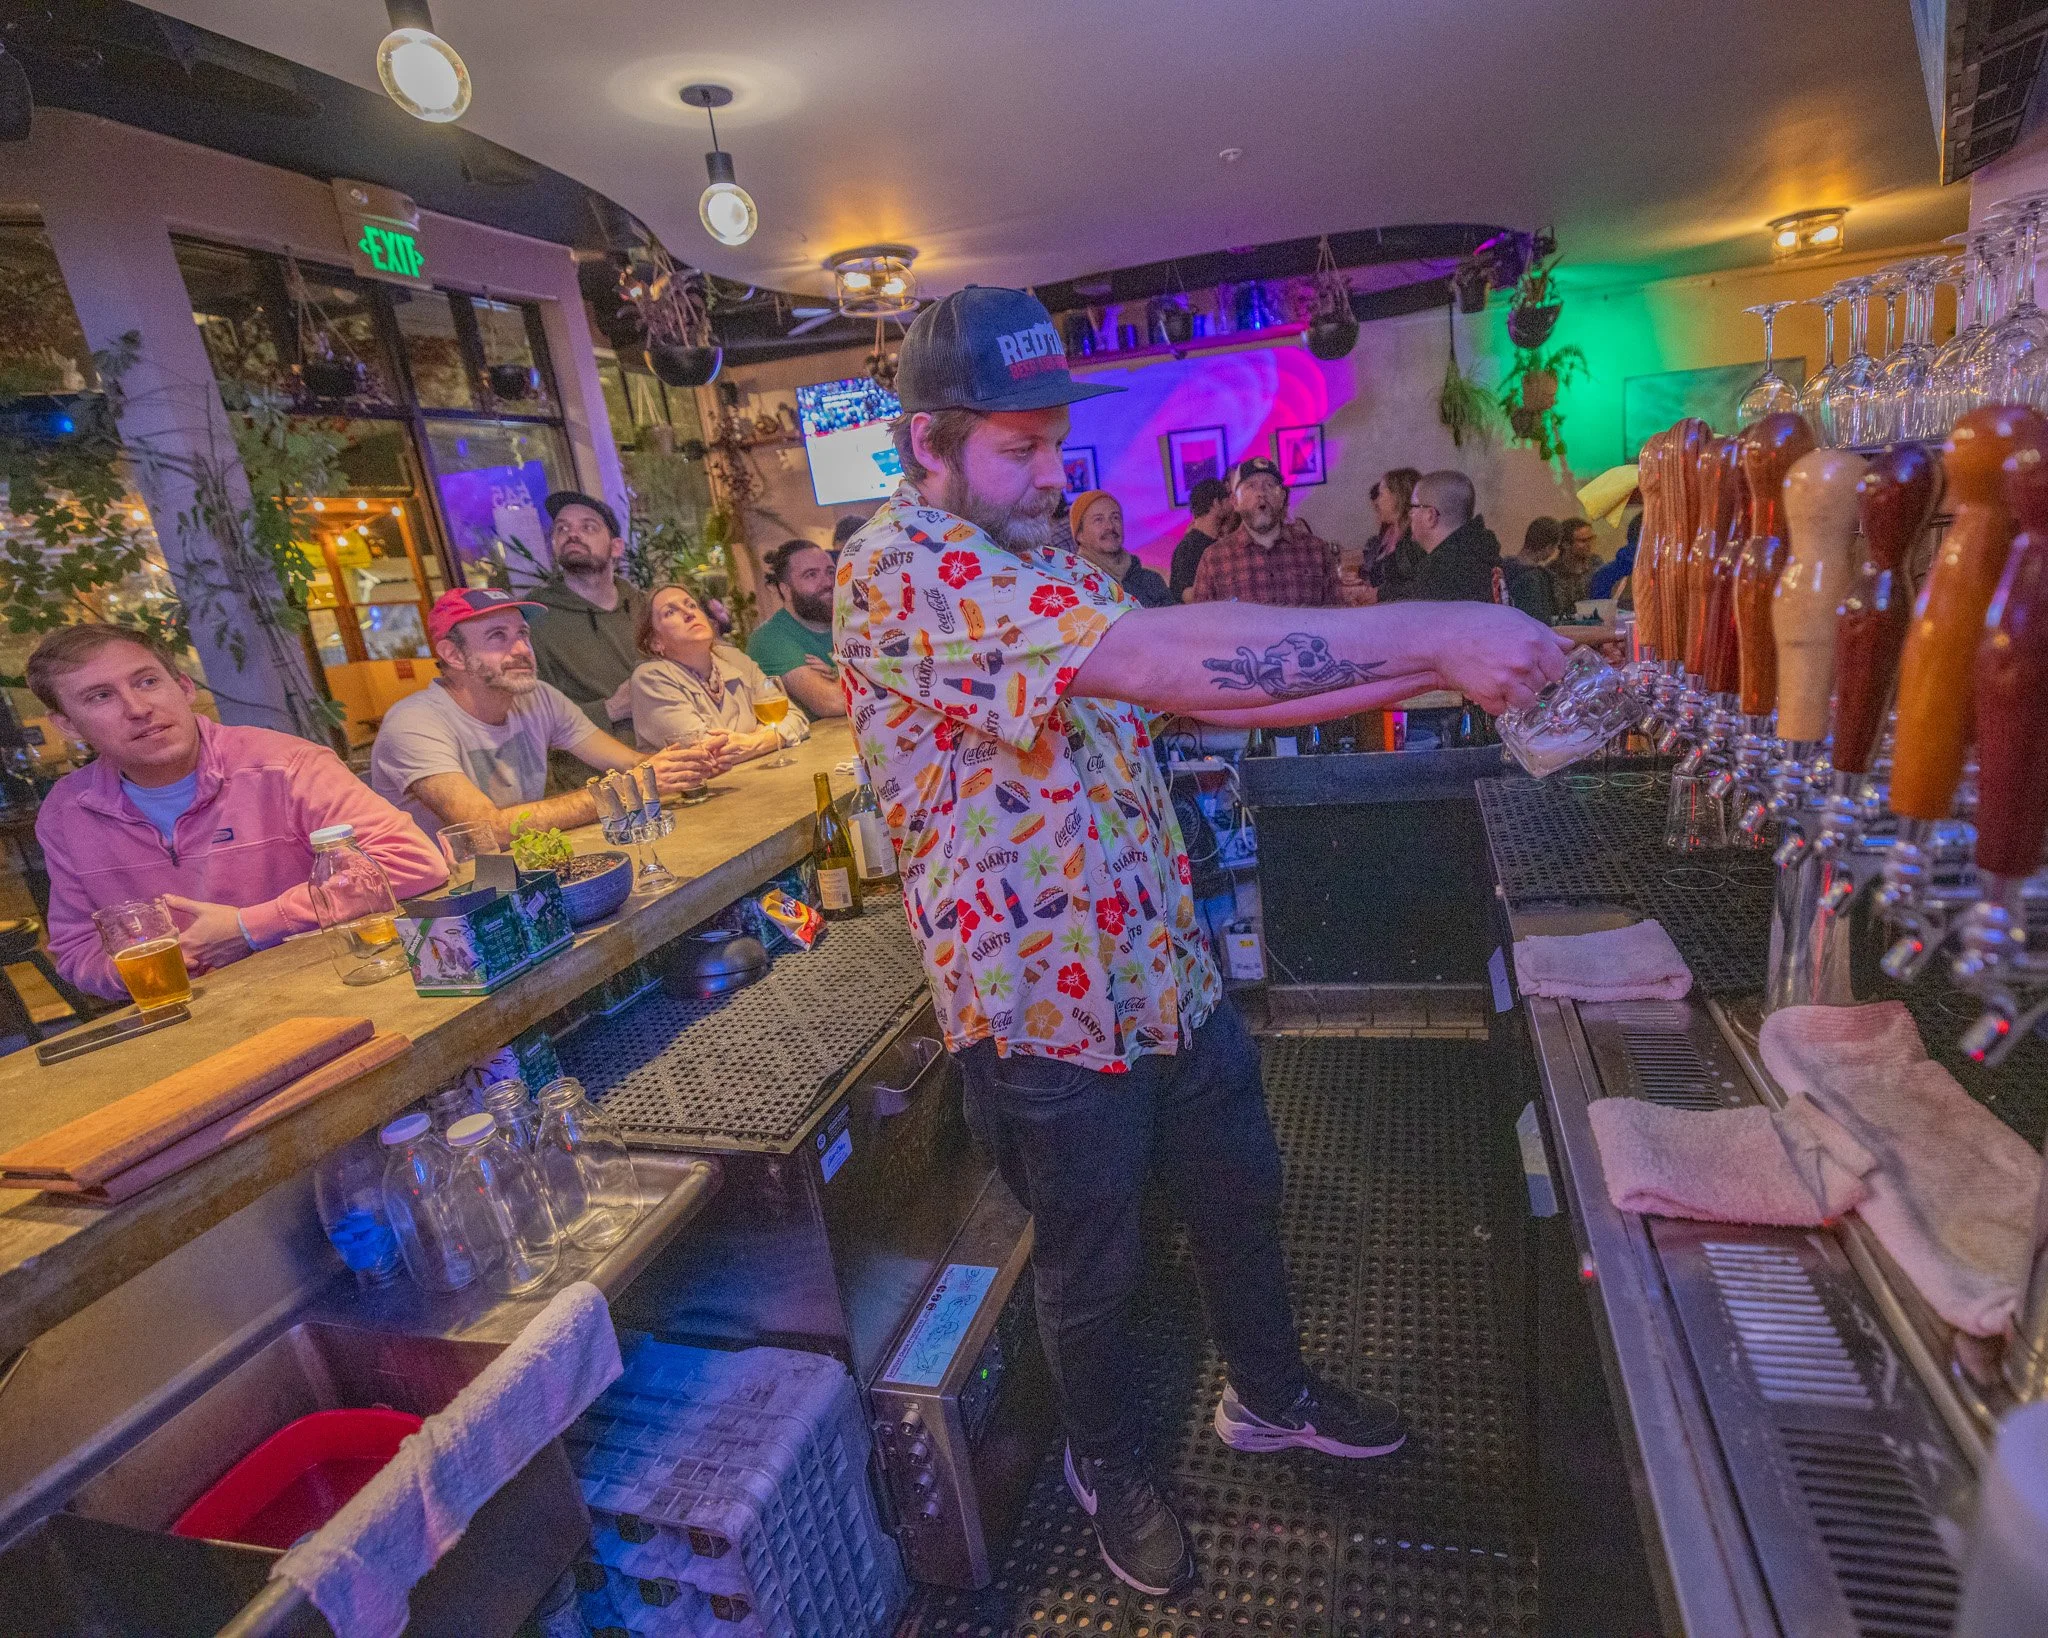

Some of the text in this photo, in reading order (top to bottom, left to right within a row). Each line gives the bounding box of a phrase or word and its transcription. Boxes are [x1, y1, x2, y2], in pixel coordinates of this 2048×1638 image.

[363, 226, 420, 278] EXIT
[976, 850, 1019, 873] GIANTS
[1112, 851, 1148, 873] GIANTS
[971, 931, 1012, 961] GIANTS
[1071, 1006, 1107, 1044] GIANTS
